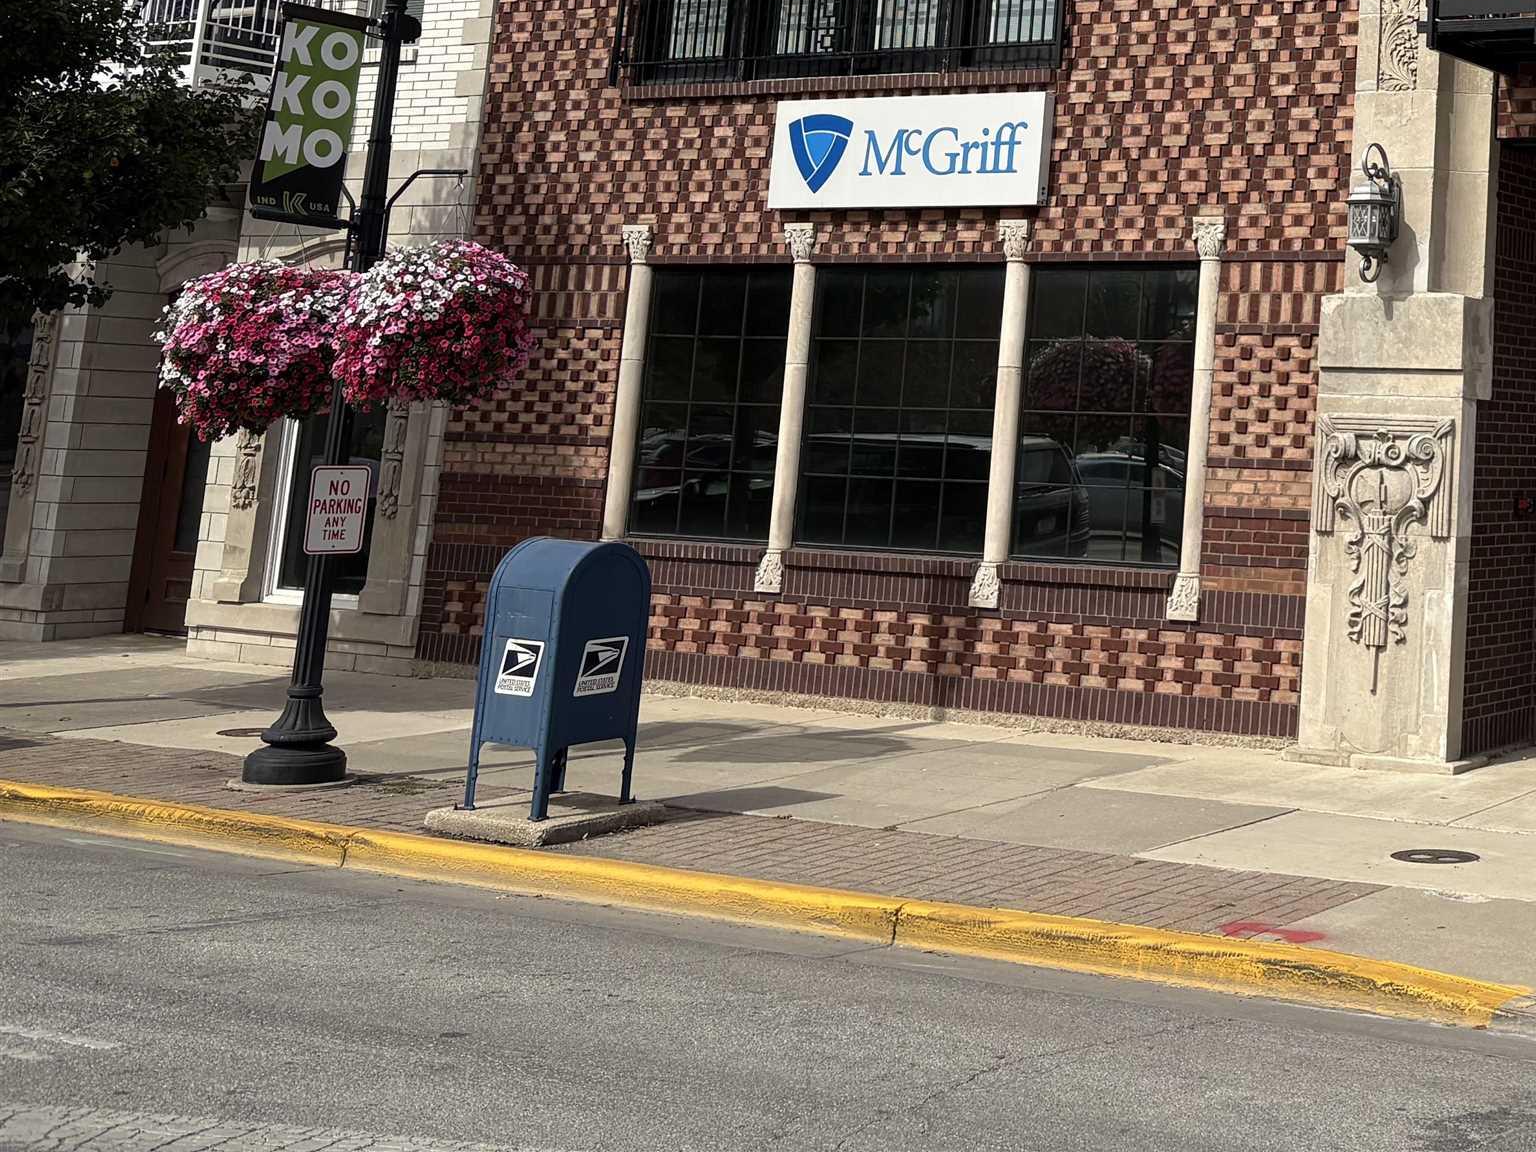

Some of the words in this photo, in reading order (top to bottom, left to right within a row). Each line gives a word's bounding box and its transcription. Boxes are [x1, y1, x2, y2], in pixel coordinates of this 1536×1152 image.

[858, 121, 1029, 177] McGriff
[256, 195, 277, 205] IND
[309, 202, 330, 213] USA
[328, 479, 351, 496] NO
[312, 498, 362, 515] PARKING
[324, 516, 347, 528] ANY
[322, 529, 346, 540] TIME
